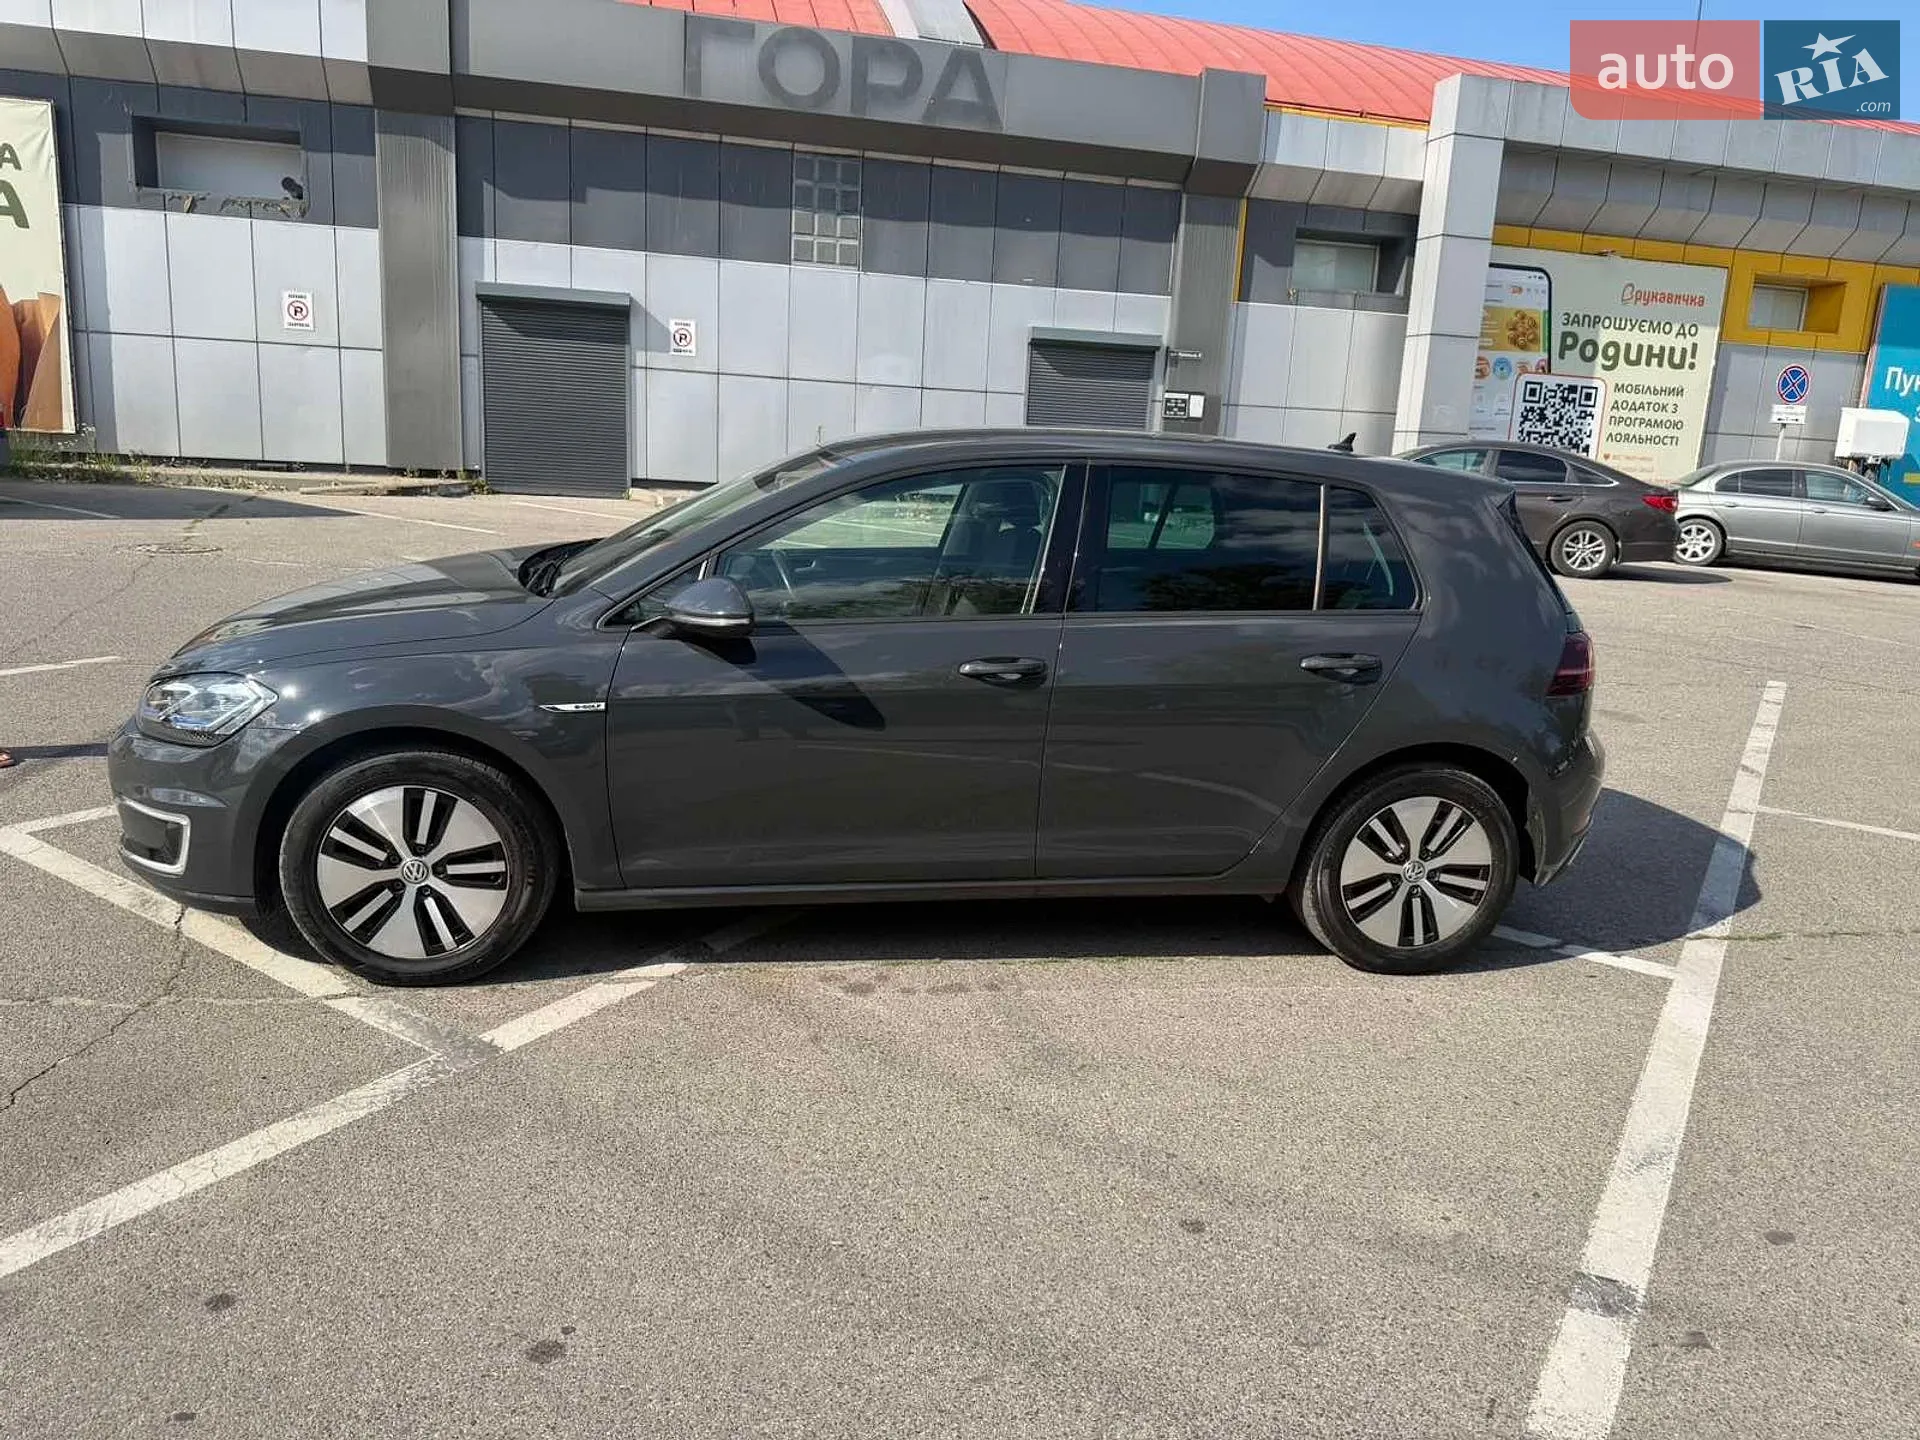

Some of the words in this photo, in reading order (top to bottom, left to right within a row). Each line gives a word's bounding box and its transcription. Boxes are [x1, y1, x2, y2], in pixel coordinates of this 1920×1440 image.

[687, 15, 1004, 130] ГОРА
[1561, 312, 1673, 336] ЗАПРОШУЄМО
[1675, 323, 1699, 339] ДО
[1558, 331, 1698, 371] Родини!
[1613, 383, 1685, 398] МОБІЛЬНИЙ
[1610, 400, 1669, 413] ДОДАТОК
[1608, 415, 1684, 430] ПРОГРАМОЮ
[1605, 432, 1680, 446] ЛОЯЛЬНОСТІ
